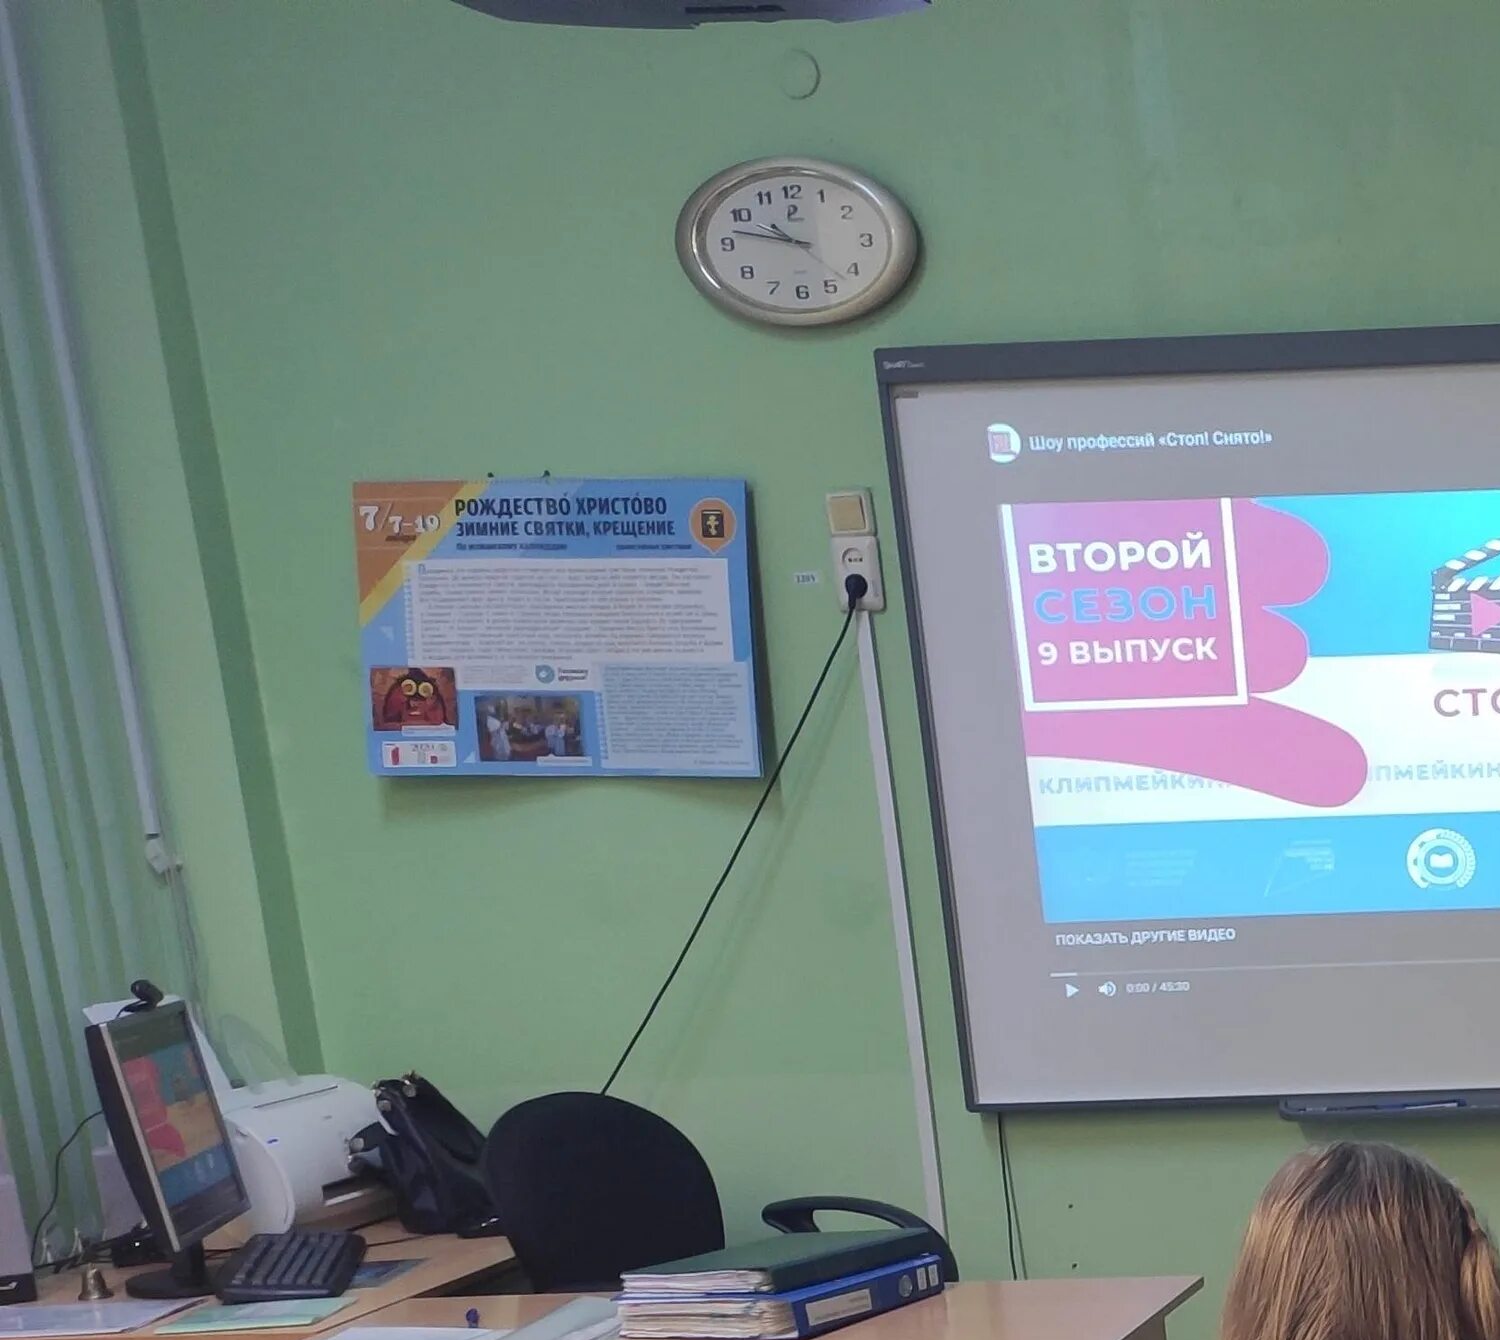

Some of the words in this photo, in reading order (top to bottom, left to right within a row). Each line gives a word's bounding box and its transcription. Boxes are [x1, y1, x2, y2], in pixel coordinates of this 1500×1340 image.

[756, 191, 772, 205] 11
[782, 184, 802, 199] 12
[816, 189, 825, 203] 1
[730, 208, 752, 222] 10
[840, 205, 853, 220] 2
[720, 237, 735, 252] 9
[859, 233, 874, 247] 3
[740, 265, 755, 279] 8
[847, 262, 860, 276] 4
[767, 281, 781, 295] 7
[795, 285, 810, 299] 6
[823, 280, 838, 294] 5
[1029, 436, 1063, 452] Шоу
[1067, 432, 1155, 452] профессий
[1158, 432, 1209, 448] «Стоп!
[1212, 430, 1272, 447] Снято!»
[456, 521, 519, 536] ЗИМНИЕ
[524, 520, 590, 538] СВЯТКИ,
[593, 520, 675, 538] КРЕЩЕНИЕ
[1029, 531, 1212, 574] ВТОРОЙ
[1033, 584, 1217, 624] СЕЗОН
[1037, 642, 1058, 666] 9
[1069, 636, 1218, 665] ВЫПУСК
[1055, 932, 1129, 946] ПОКАЗАТЬ
[1130, 930, 1186, 946] ДРУГИЕ
[1188, 928, 1236, 942] ВИДЕО
